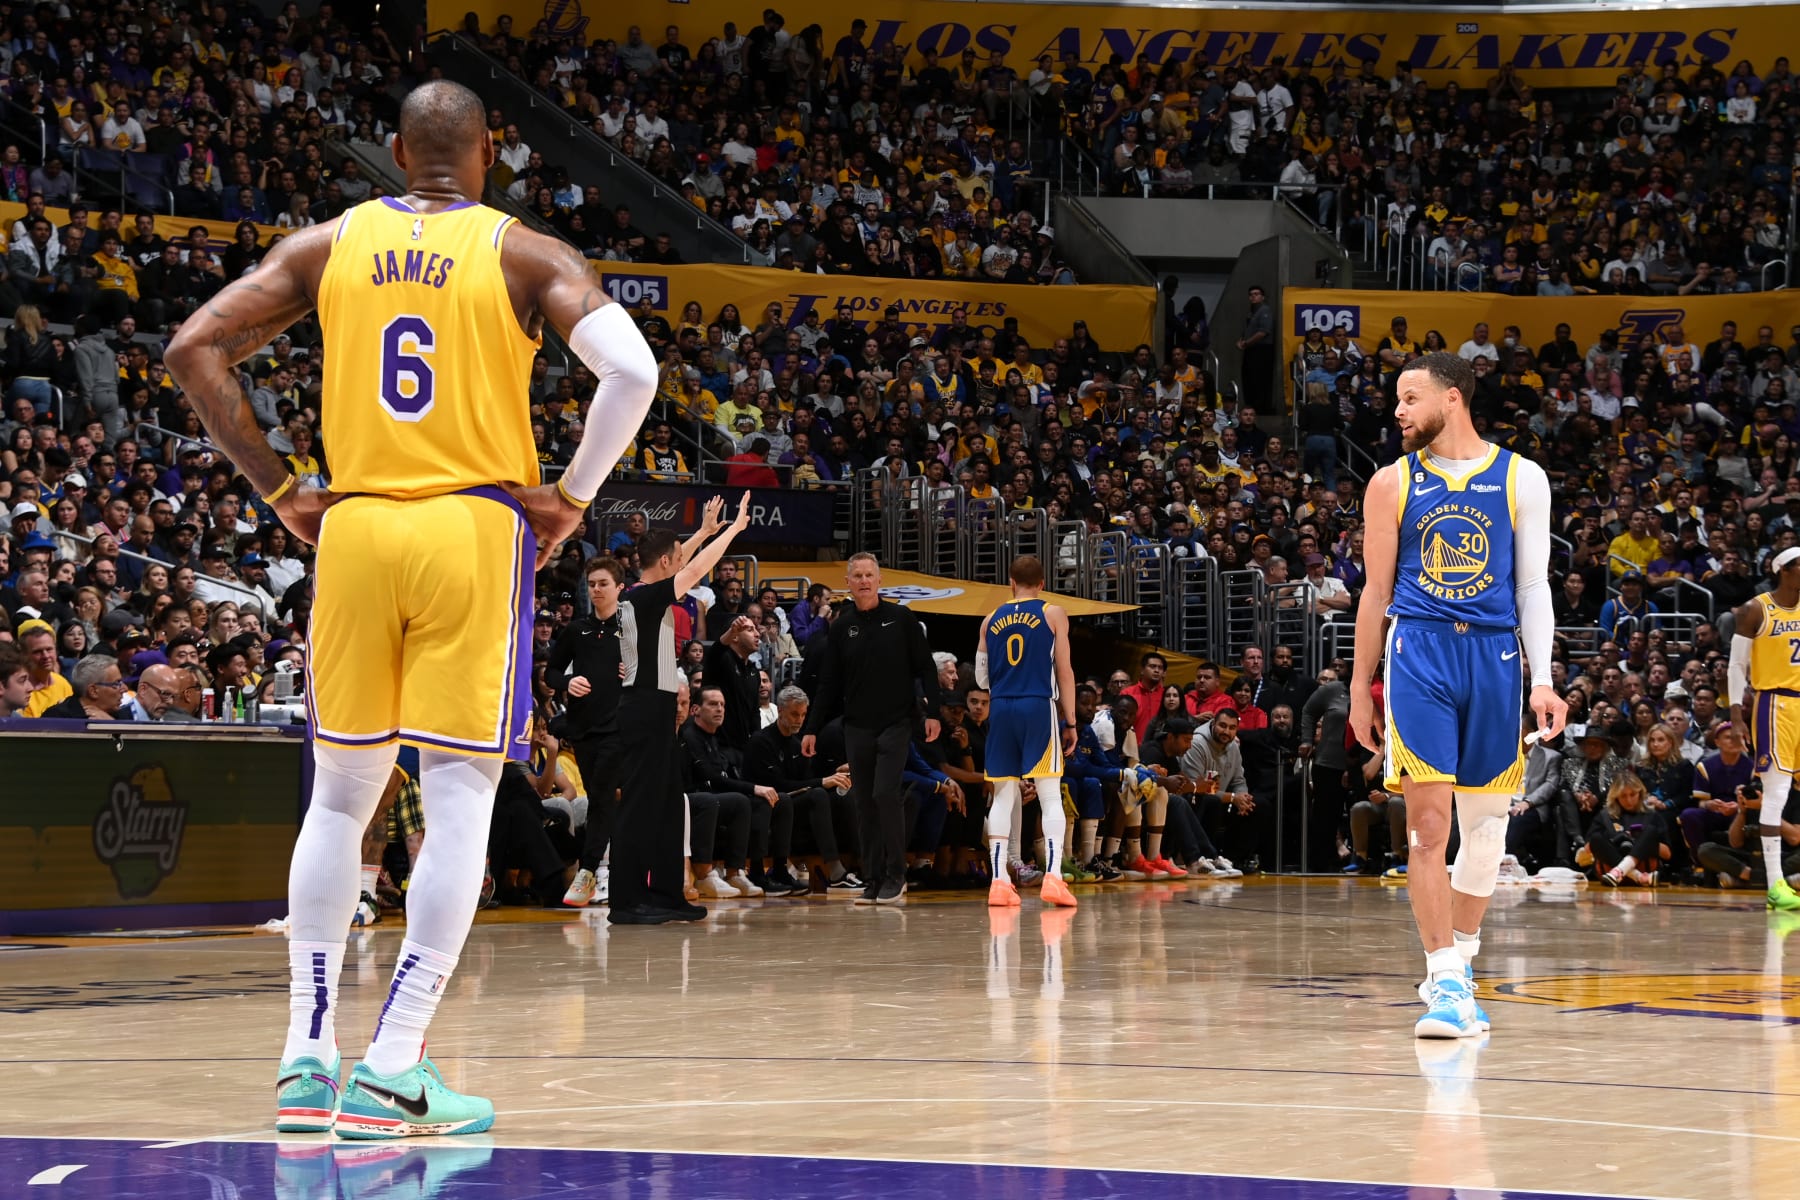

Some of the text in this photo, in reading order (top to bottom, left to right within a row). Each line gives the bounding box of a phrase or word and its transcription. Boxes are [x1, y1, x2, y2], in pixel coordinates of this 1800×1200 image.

[1457, 23, 1478, 34] 206
[868, 19, 1738, 70] LOS ANGELES LAKERS
[371, 249, 454, 289] JAMES
[608, 278, 661, 304] 105
[832, 295, 1008, 317] LOS ANGELES
[1300, 308, 1355, 332] 106
[377, 313, 436, 423] 6
[1414, 472, 1425, 483] 6
[1470, 483, 1502, 493] Rakuten
[1416, 503, 1494, 531] GOLDEN STATE
[1457, 532, 1485, 554] 30
[1416, 571, 1495, 601] WARRIORS
[990, 611, 1041, 636] DIVINCENZO
[1006, 633, 1025, 667] 0
[95, 781, 186, 871] Starry
